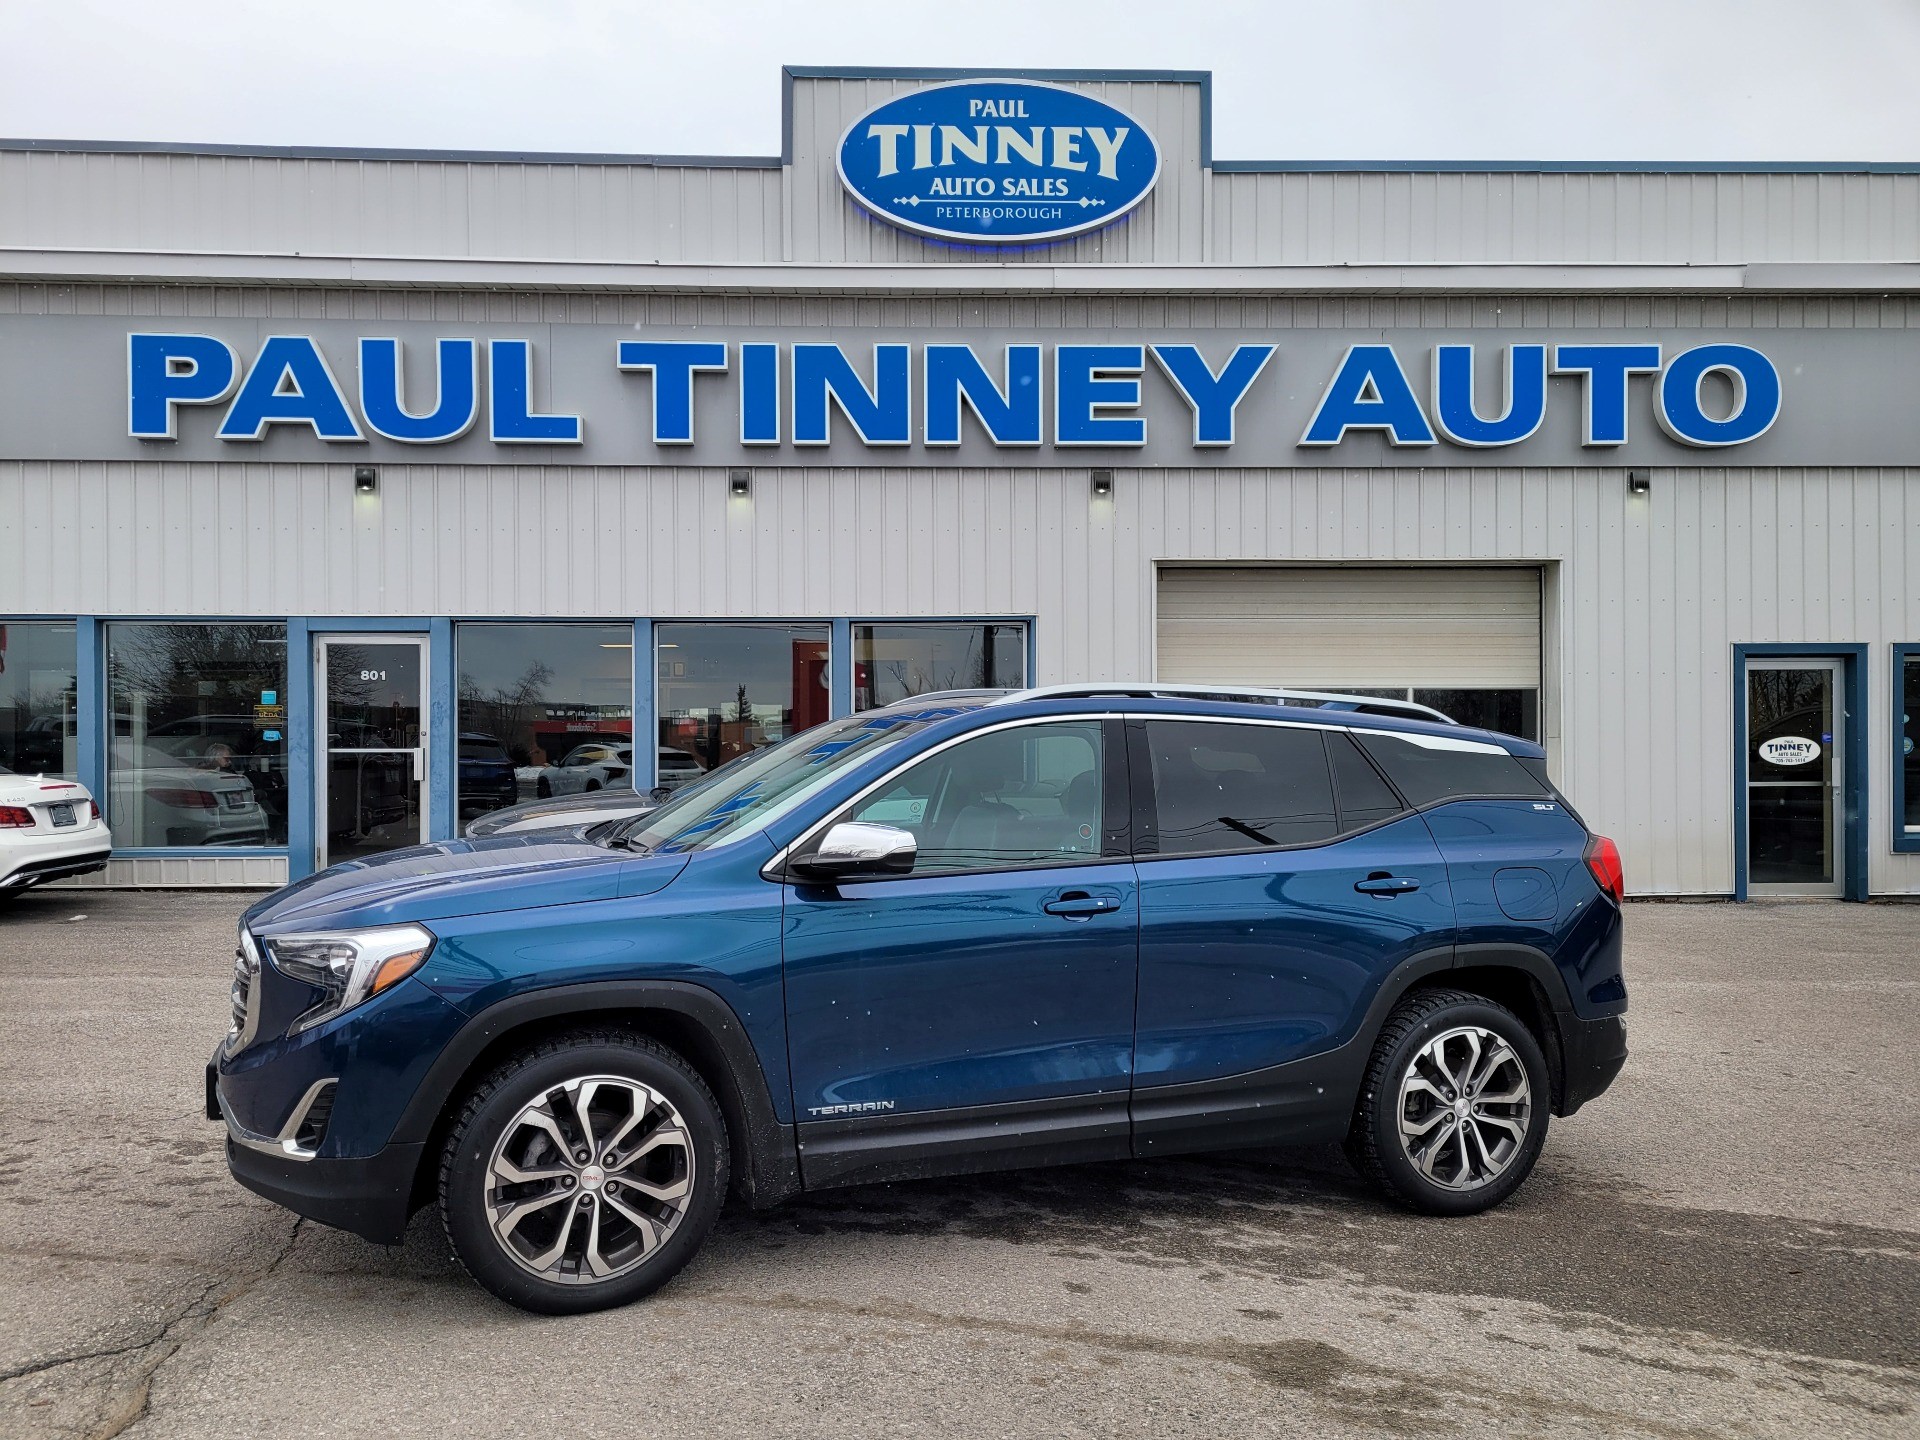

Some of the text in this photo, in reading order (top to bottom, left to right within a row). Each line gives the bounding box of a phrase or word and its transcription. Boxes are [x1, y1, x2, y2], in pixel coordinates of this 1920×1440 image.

[969, 99, 1029, 118] PAUL
[867, 124, 1130, 181] TINNEY
[929, 177, 1069, 197] AUTO SALES
[936, 206, 1062, 219] PETERBOROUGH
[127, 332, 1783, 448] PAUL TINNEY AUTO
[360, 670, 386, 681] 801
[1767, 744, 1812, 754] TINNEY
[1532, 803, 1556, 811] SLT
[807, 1100, 895, 1116] TERRAIN
